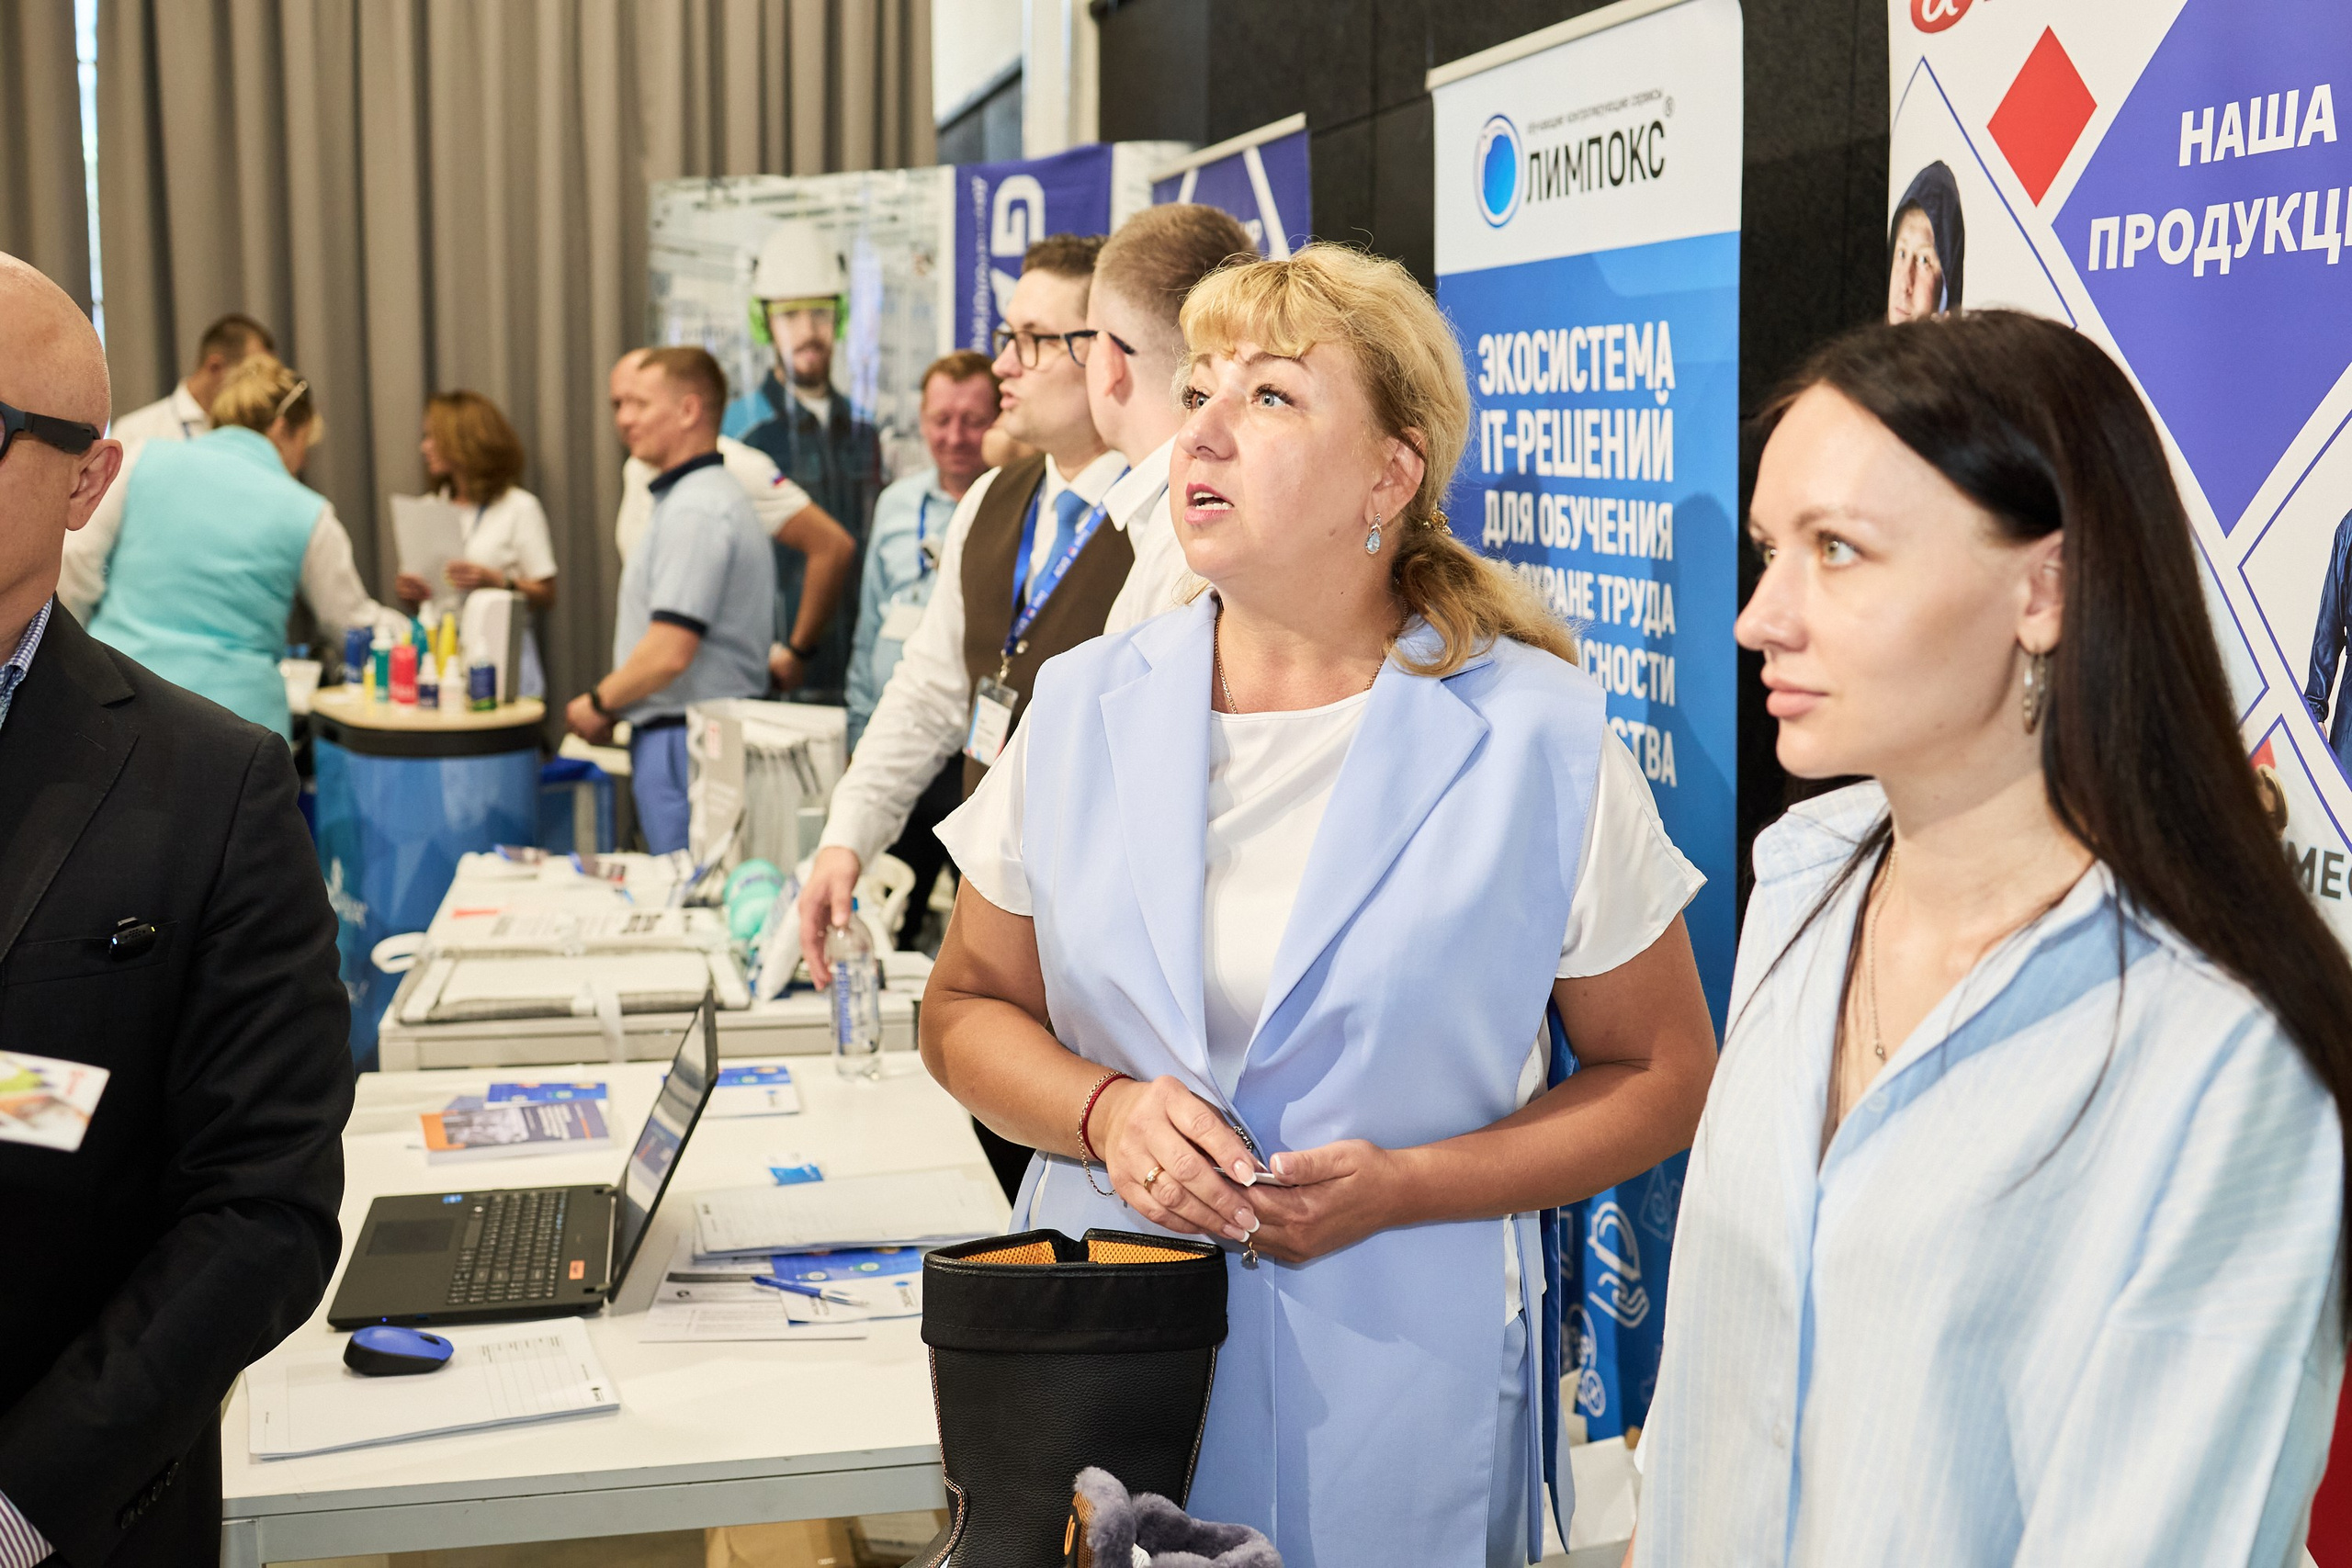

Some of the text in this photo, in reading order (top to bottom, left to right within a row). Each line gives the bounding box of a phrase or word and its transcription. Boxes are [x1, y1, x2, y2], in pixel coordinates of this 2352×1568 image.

[2178, 83, 2338, 167] НАША
[1477, 320, 1676, 396] ЭКОСИСТЕМА
[1482, 489, 1674, 562] ДЛЯ ОБУЧЕНИЯ
[1597, 573, 1677, 639] ТРУДА
[1573, 637, 1676, 707] СНОСТИ
[2287, 840, 2352, 900] МЕ
